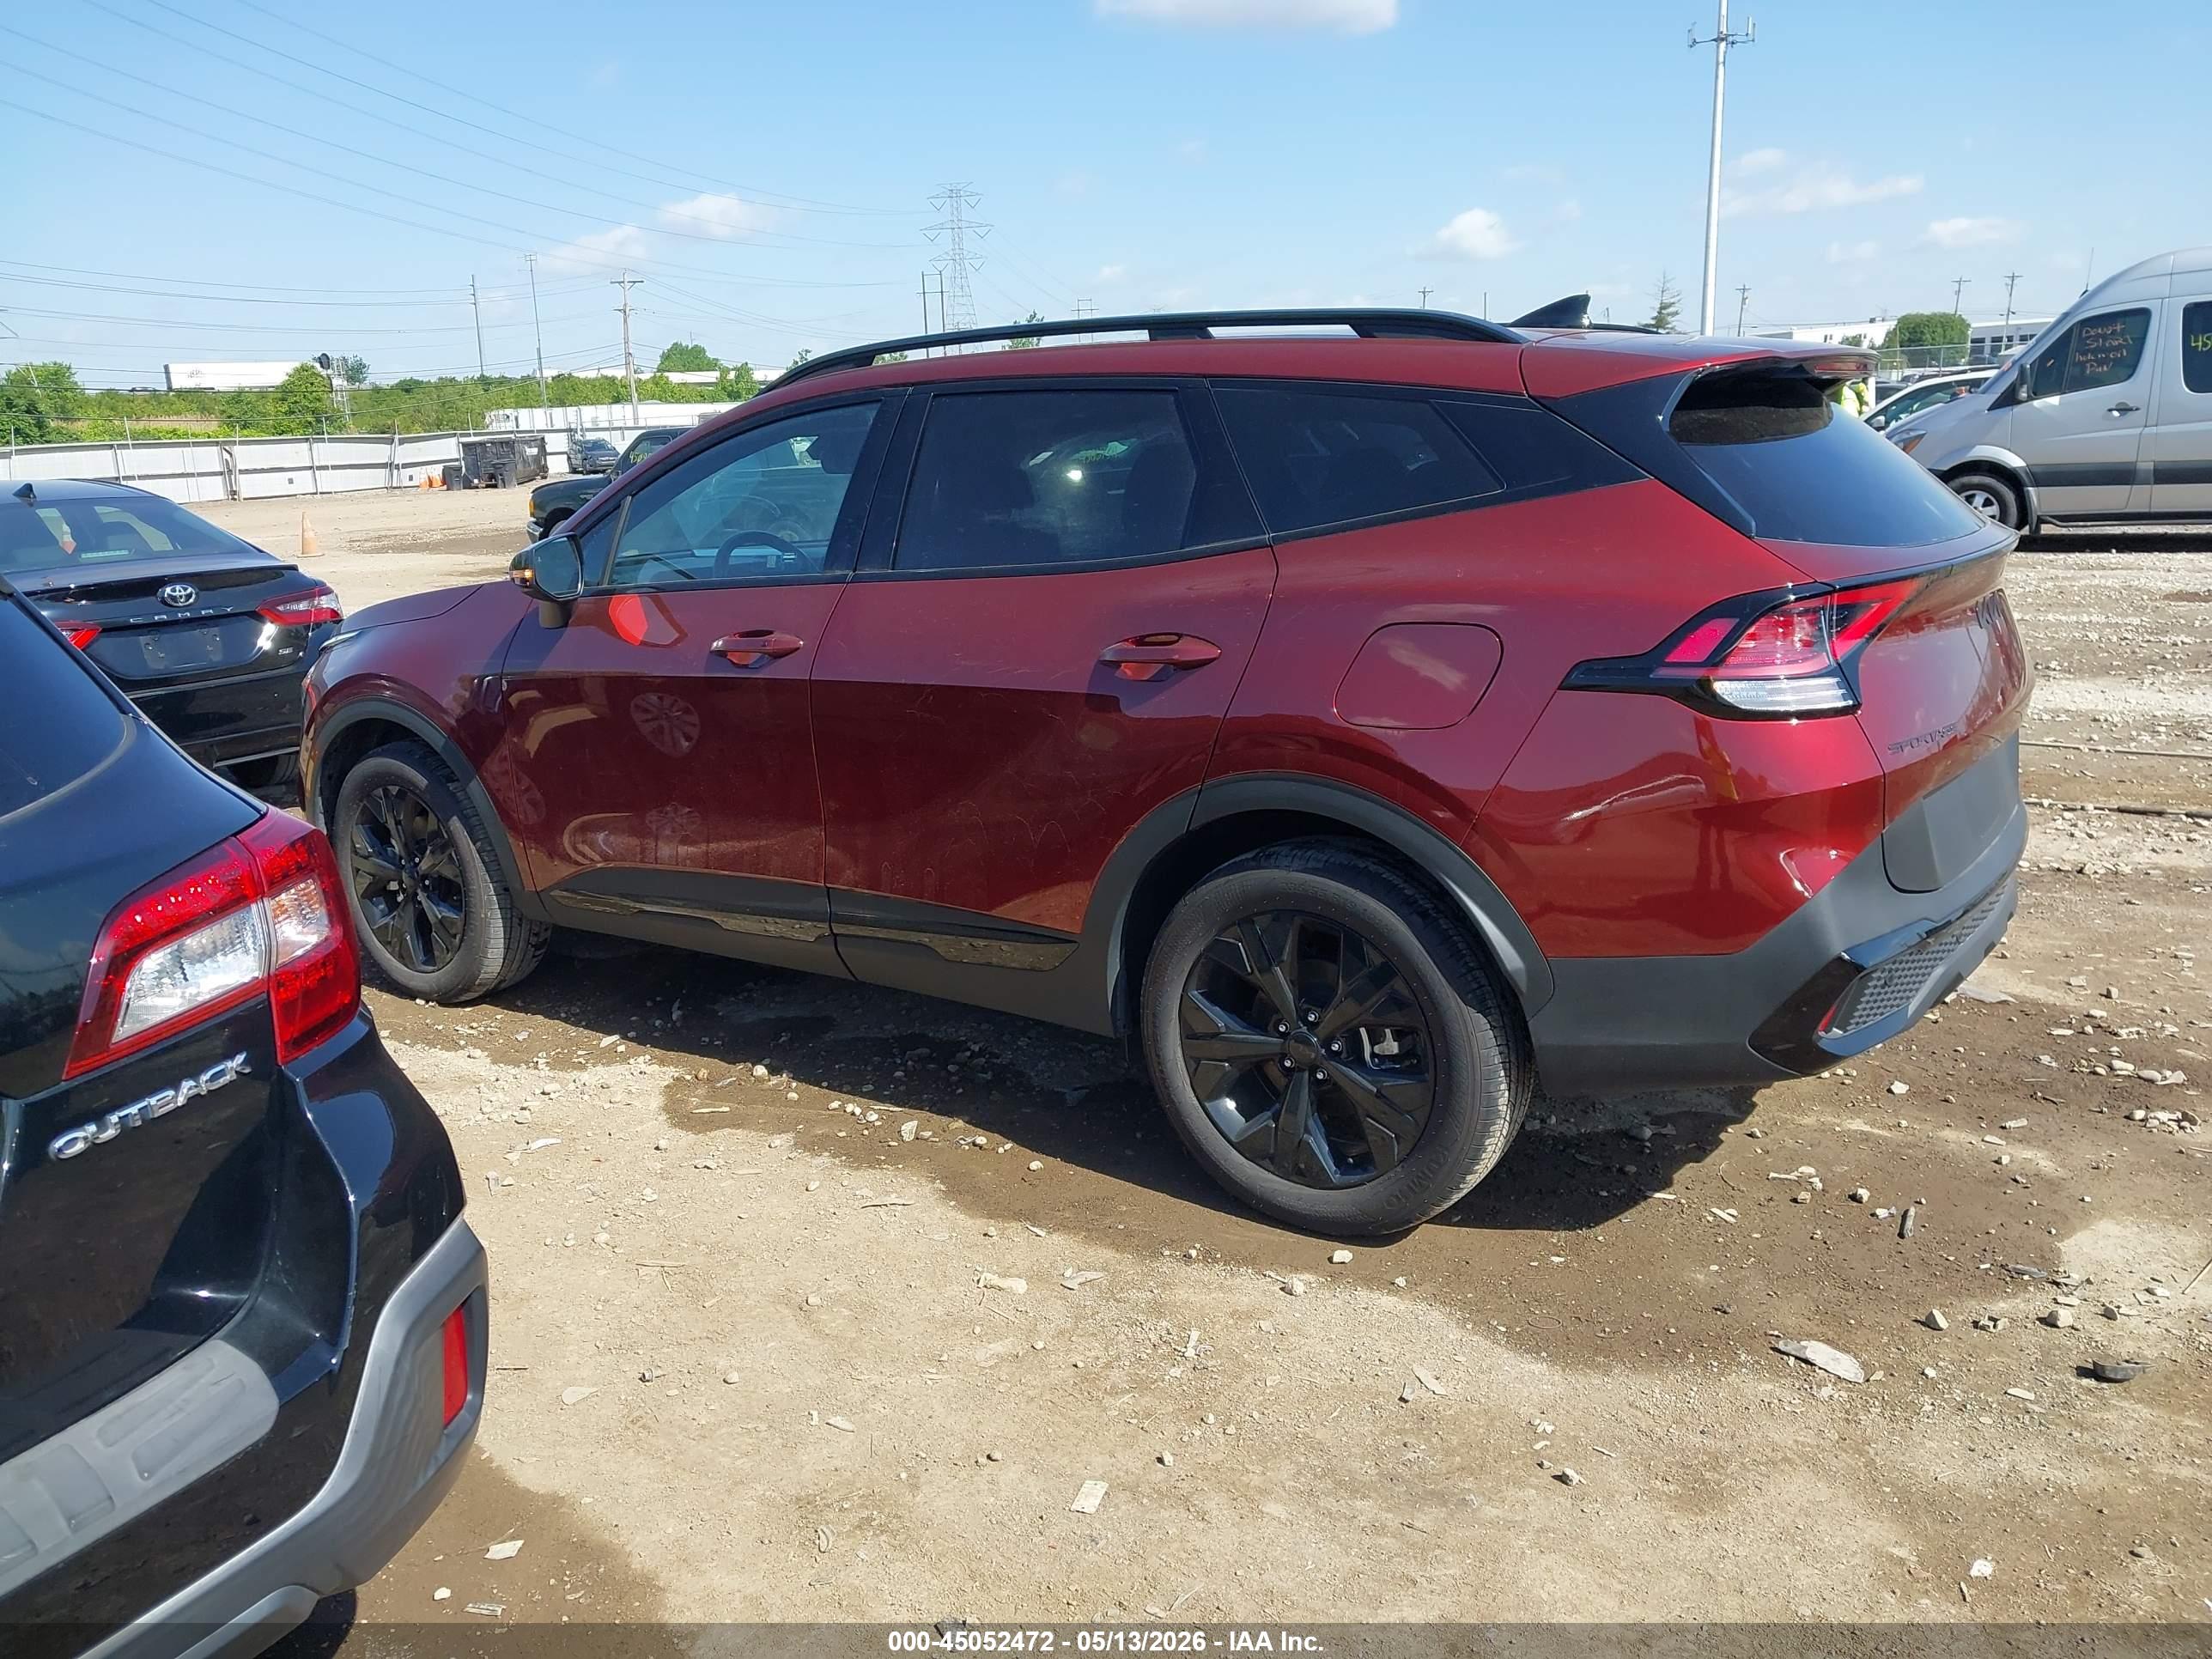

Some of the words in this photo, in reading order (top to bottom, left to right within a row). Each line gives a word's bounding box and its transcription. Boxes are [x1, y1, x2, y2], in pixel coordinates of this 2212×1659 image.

[130, 605, 234, 623] CAMRY
[278, 647, 295, 656] SE
[49, 1050, 252, 1160] OUTBACK
